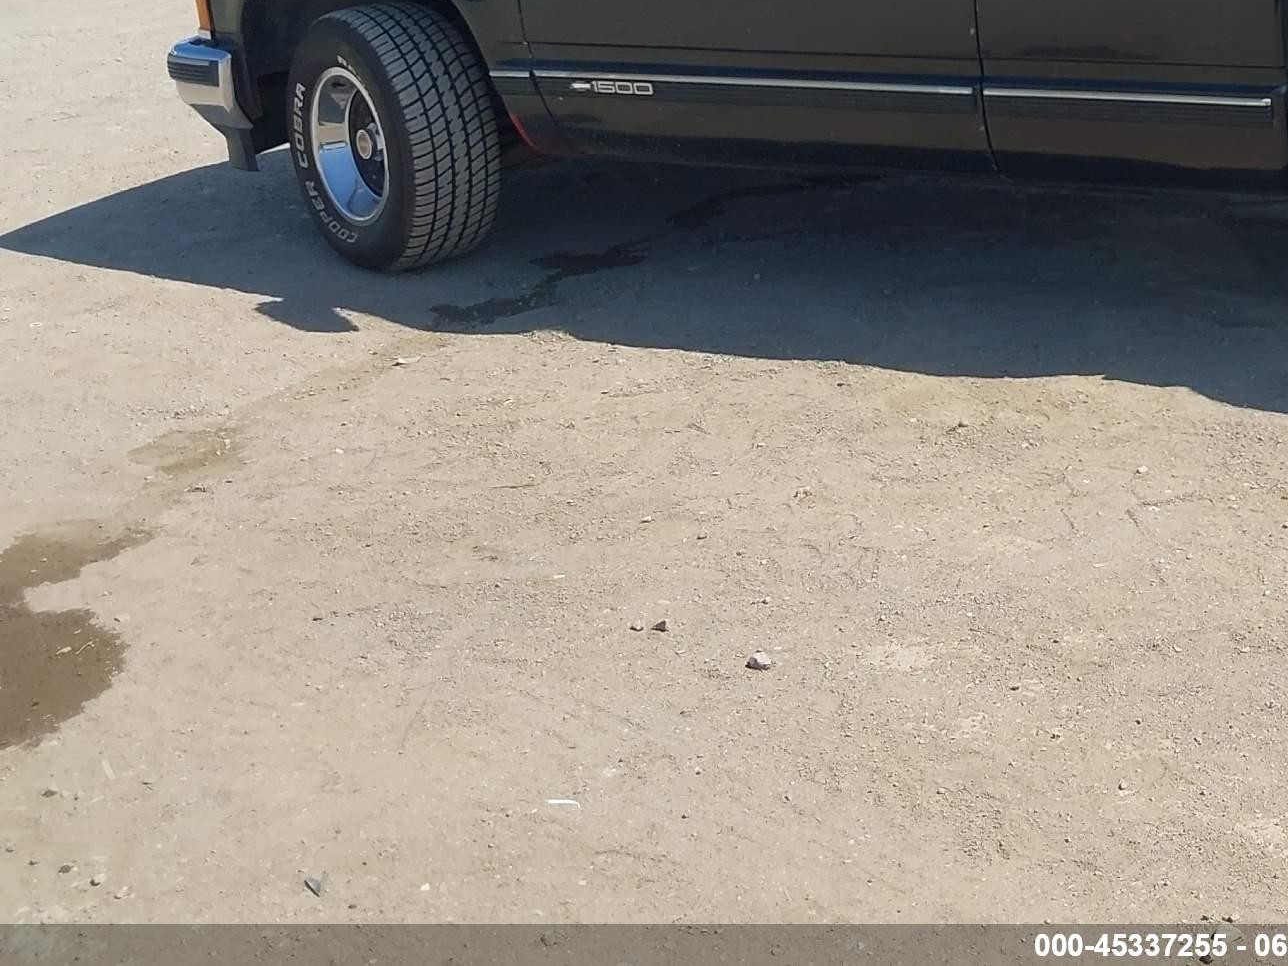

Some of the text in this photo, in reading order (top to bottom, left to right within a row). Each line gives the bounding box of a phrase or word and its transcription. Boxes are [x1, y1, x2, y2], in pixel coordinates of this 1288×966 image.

[592, 80, 653, 95] 1500
[294, 82, 358, 243] COOPER COBRA
